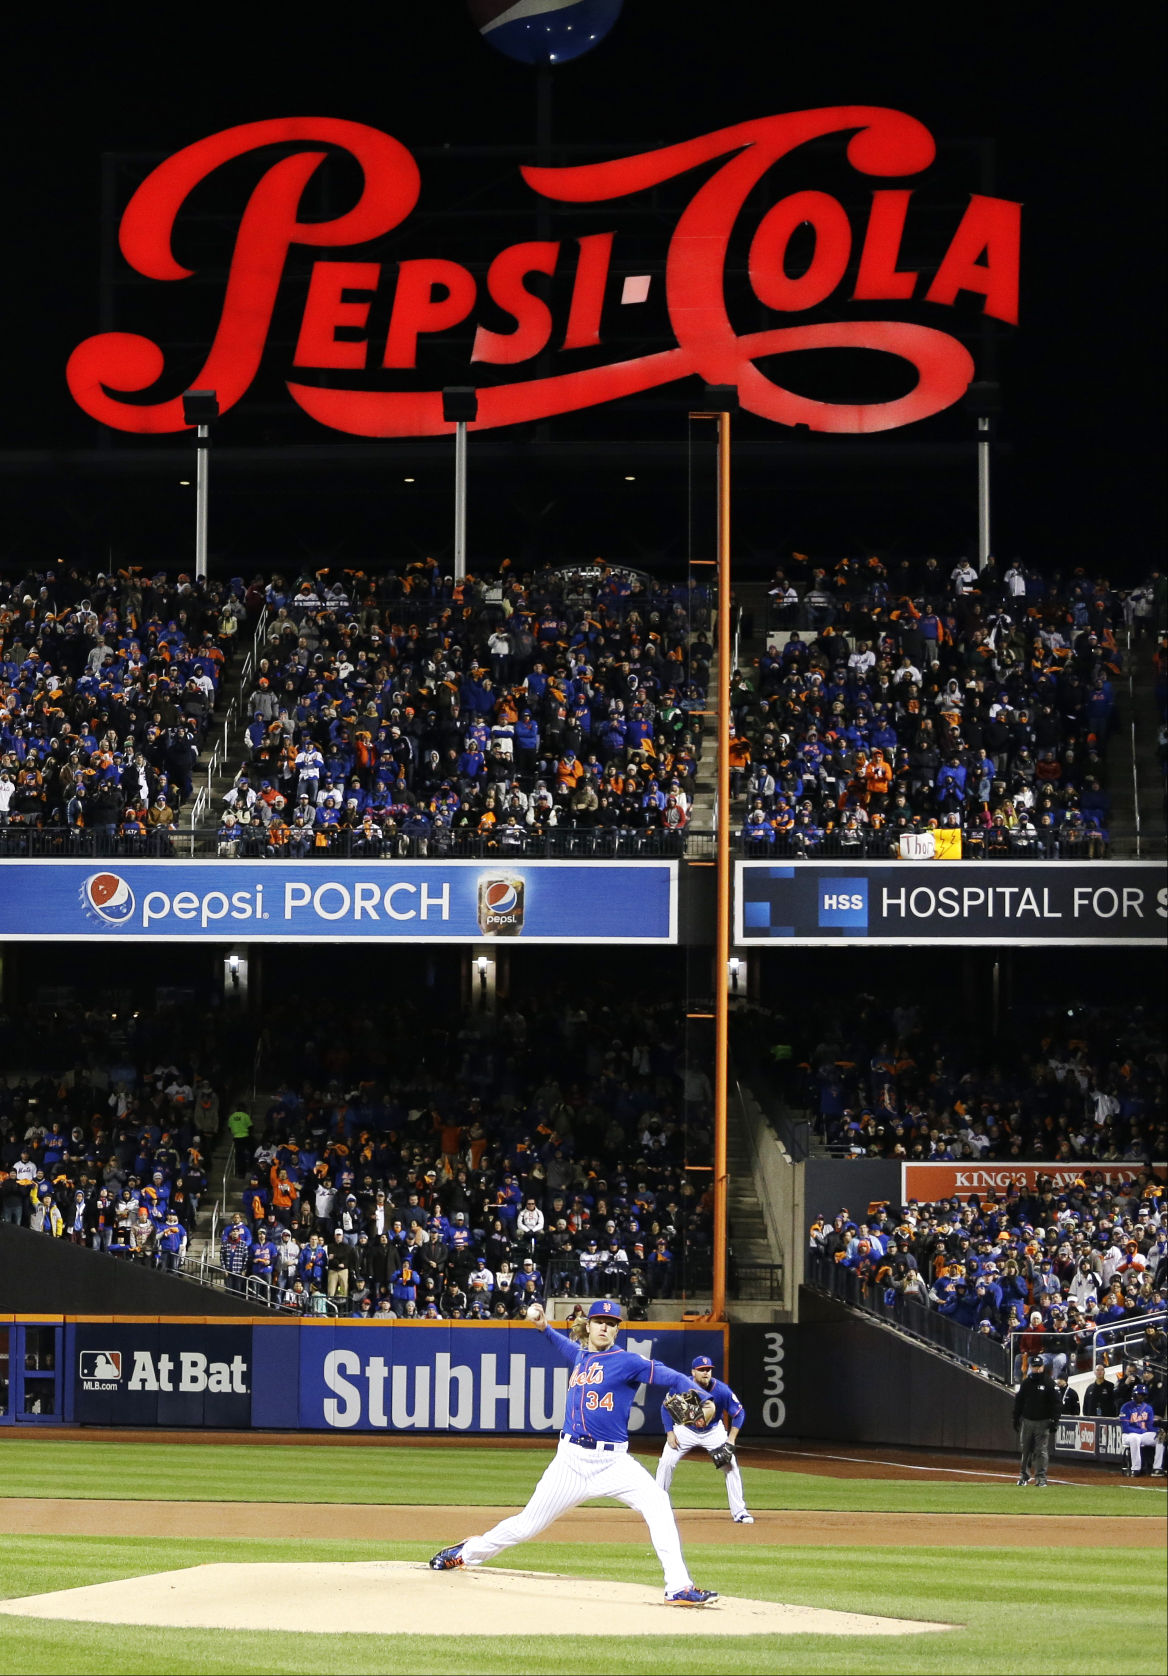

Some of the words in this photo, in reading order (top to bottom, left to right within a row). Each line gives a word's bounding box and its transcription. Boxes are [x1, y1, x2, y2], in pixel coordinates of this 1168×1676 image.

[142, 883, 264, 928] pepsi
[284, 881, 450, 921] PORCH
[823, 894, 864, 911] HSS
[882, 886, 1063, 918] HOSPITAL
[1073, 887, 1144, 918] FOR
[486, 913, 516, 926] pepsi
[128, 1351, 174, 1392] At
[179, 1351, 248, 1394] Bat
[83, 1381, 118, 1391] MLB.com
[585, 1390, 614, 1412] 34
